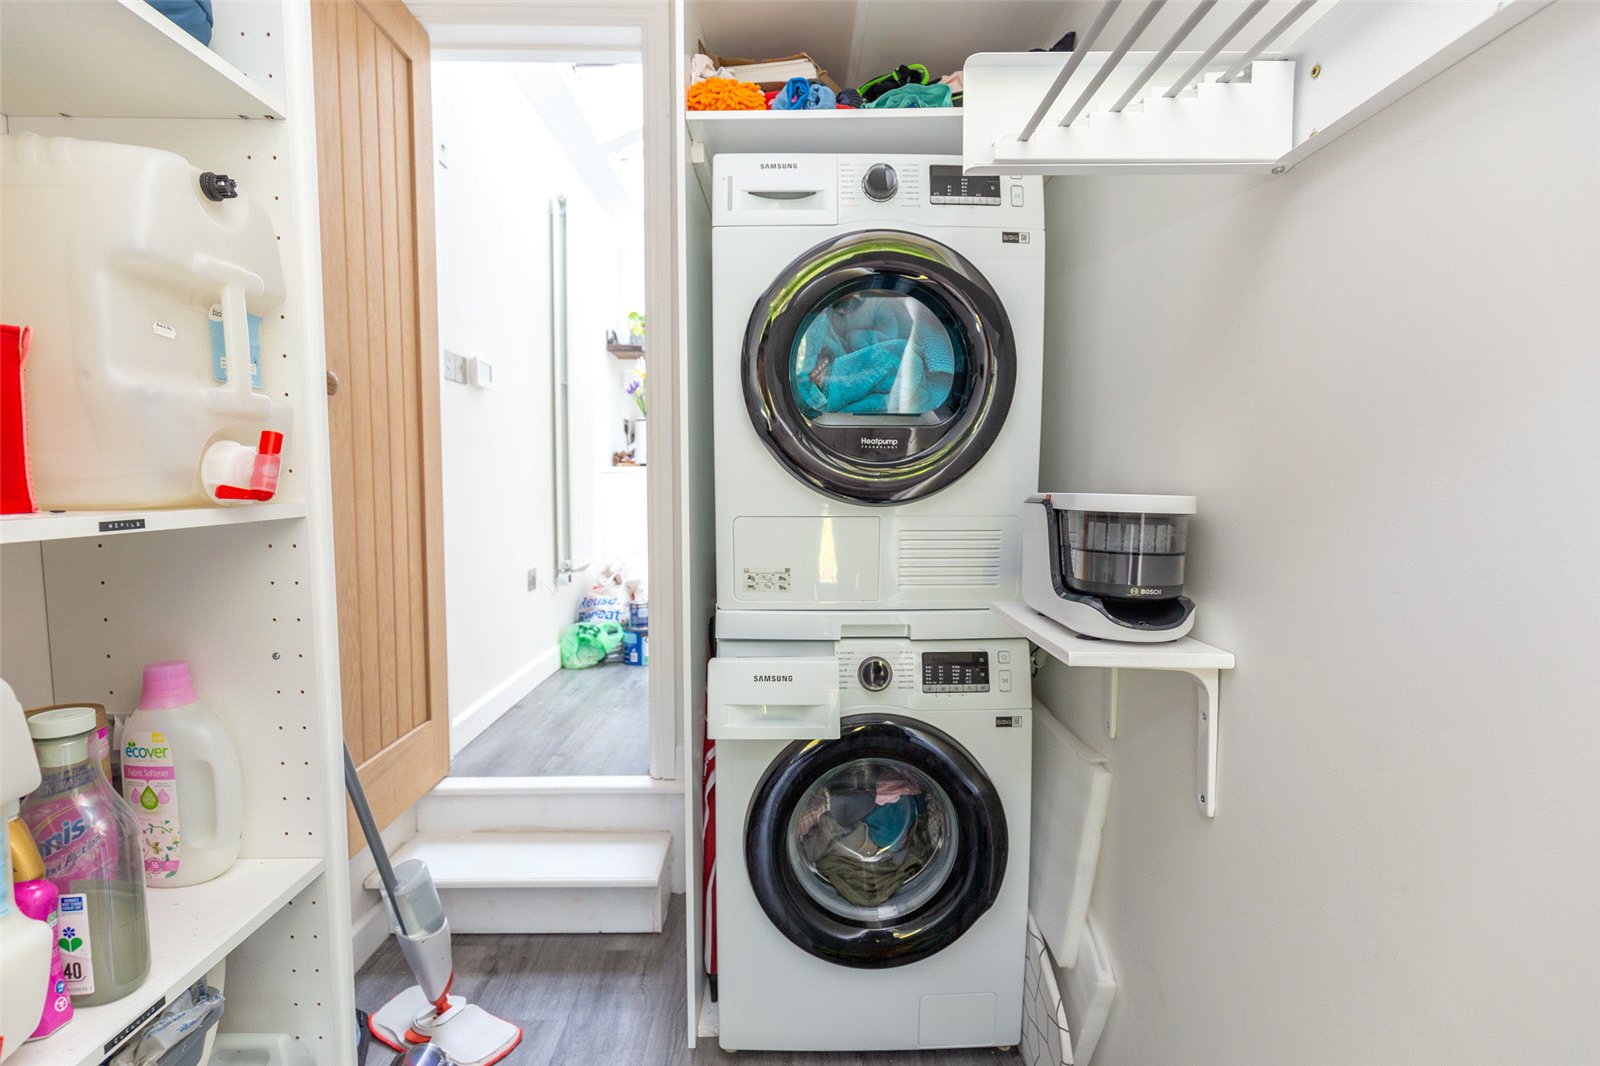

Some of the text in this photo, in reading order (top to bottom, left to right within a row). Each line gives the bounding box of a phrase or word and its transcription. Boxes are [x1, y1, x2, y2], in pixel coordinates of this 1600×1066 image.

[860, 437, 899, 446] Heatpump
[753, 673, 793, 682] SAMSUNG
[125, 746, 169, 759] ecover
[63, 961, 82, 980] 40
